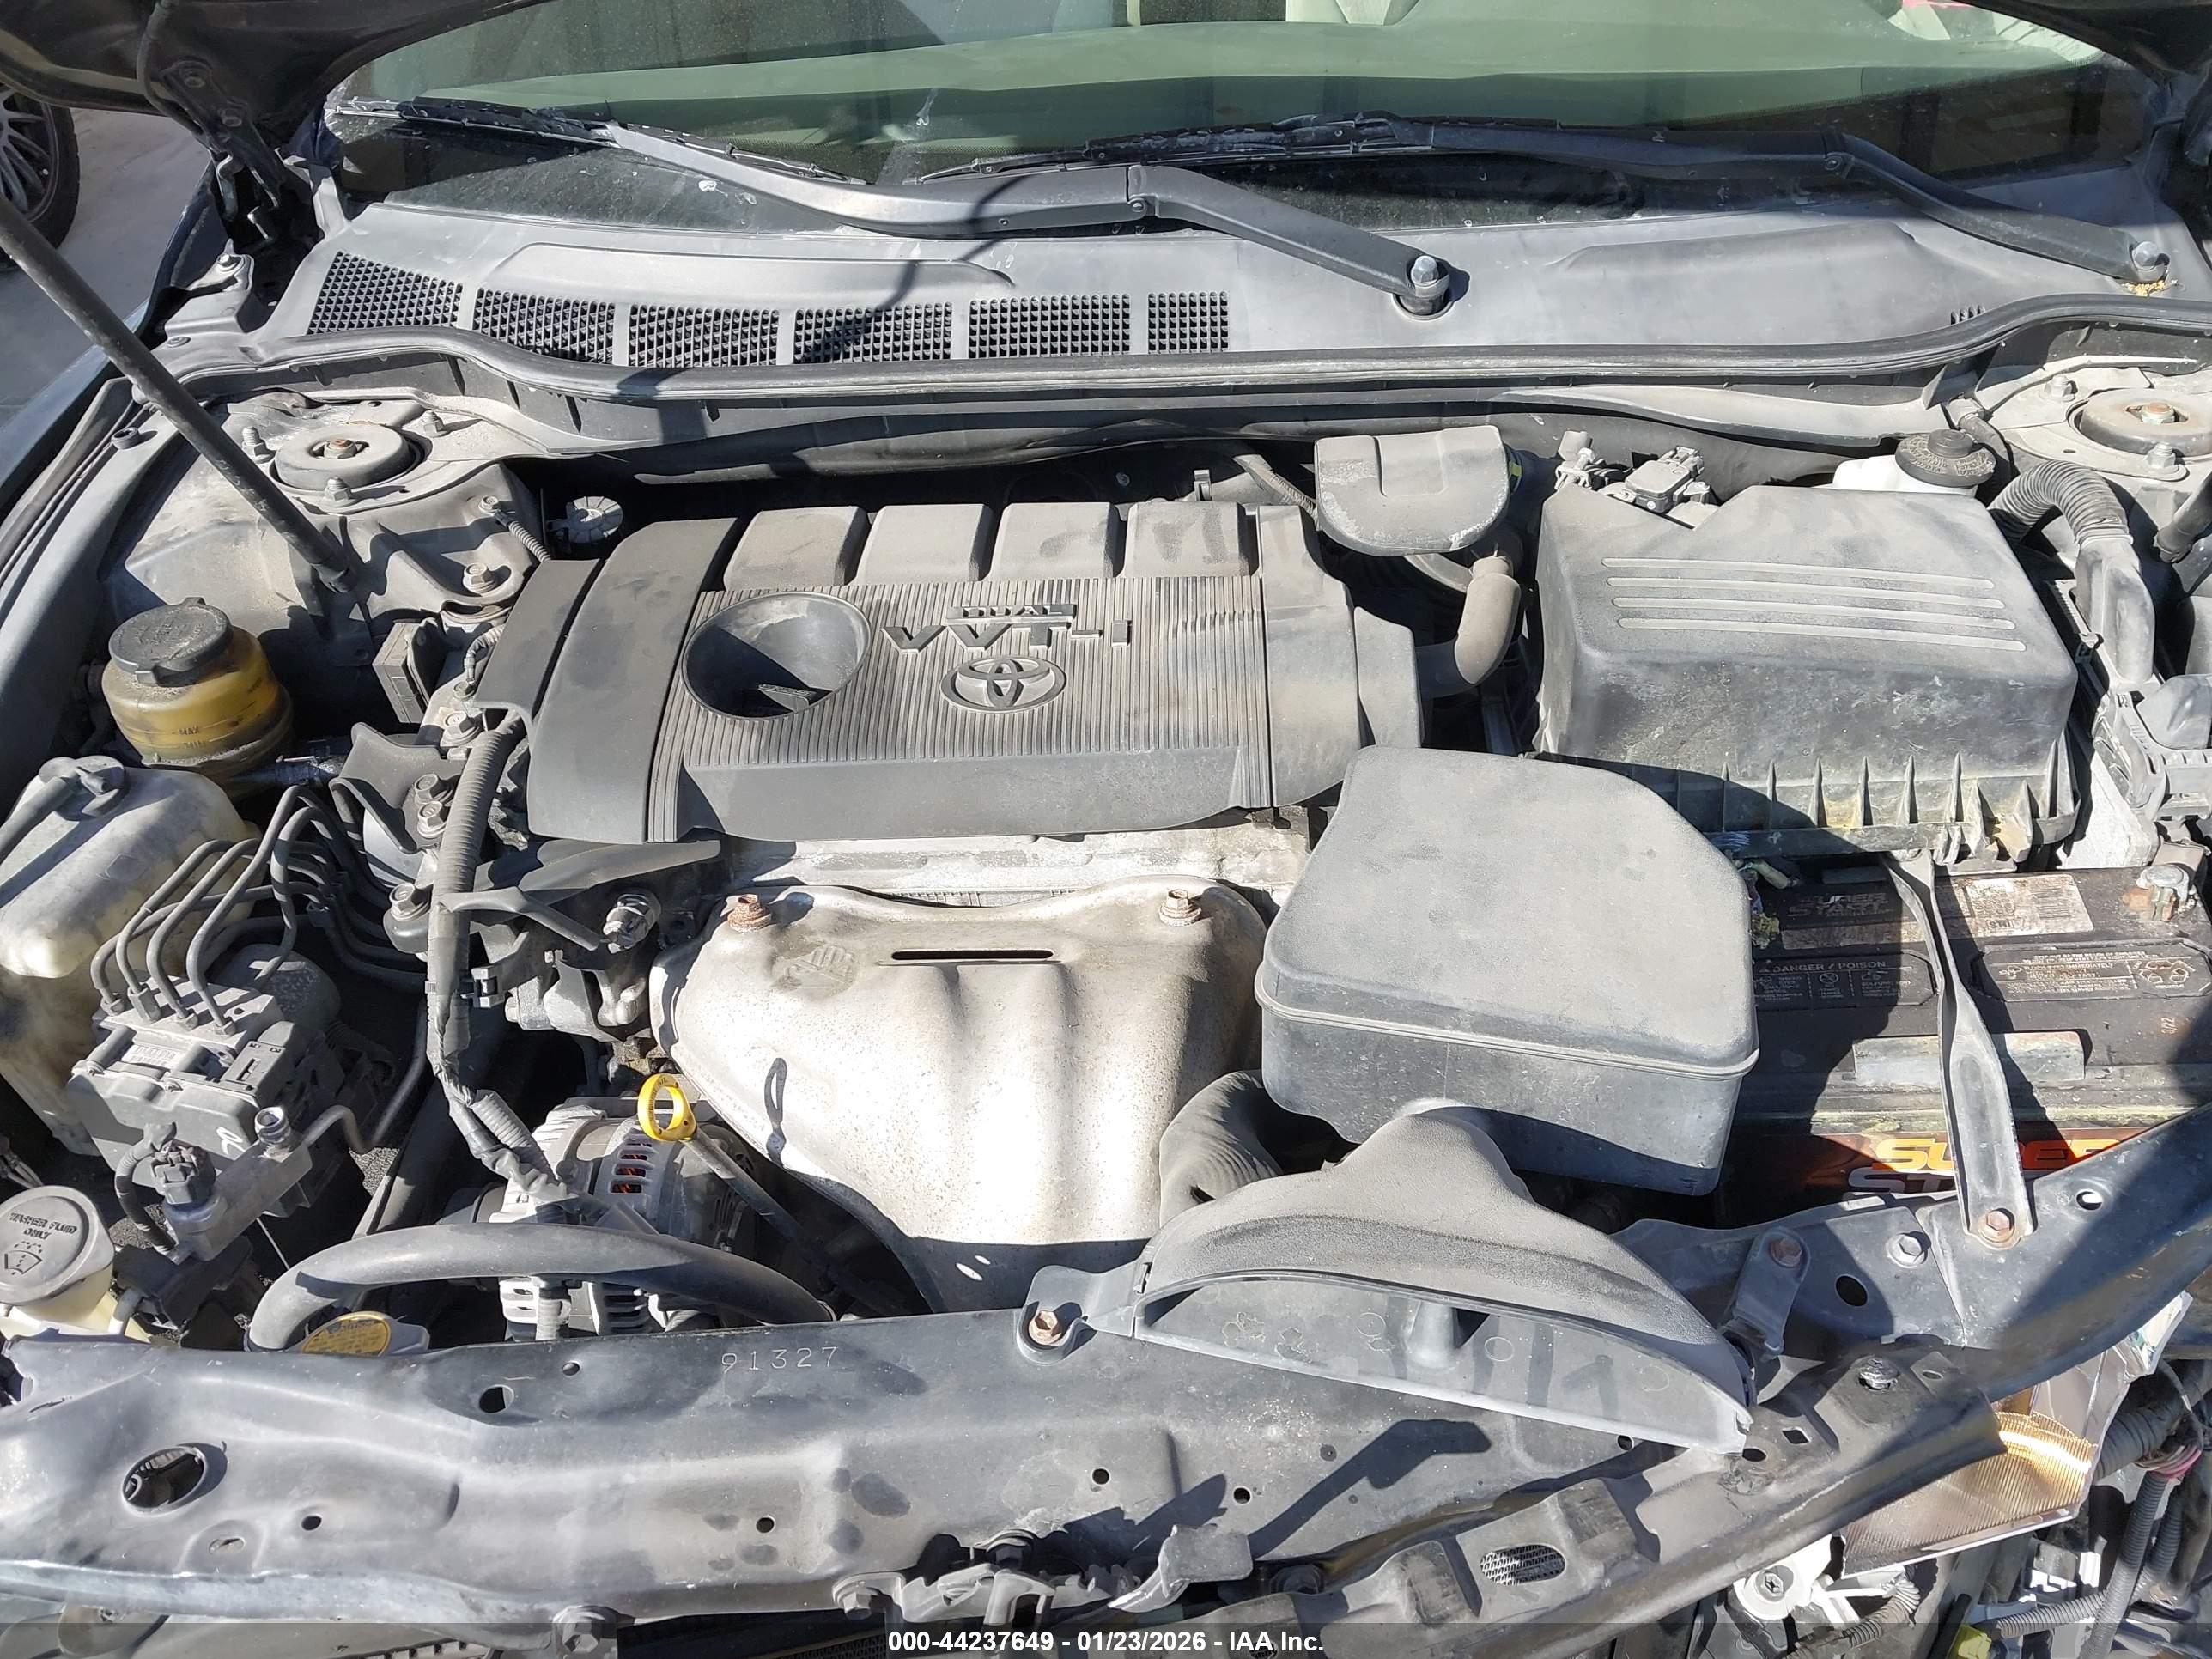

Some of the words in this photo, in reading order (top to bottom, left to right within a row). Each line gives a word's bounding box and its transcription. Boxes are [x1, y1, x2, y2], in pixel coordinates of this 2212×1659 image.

[962, 604, 1065, 618] DUAL
[1772, 963, 1825, 972] DANGER
[1838, 961, 1887, 970] POISON
[9, 1212, 48, 1228] WASHER
[49, 1221, 77, 1235] FLUID
[23, 1228, 52, 1240] ONLY
[721, 1346, 838, 1375] 91327
